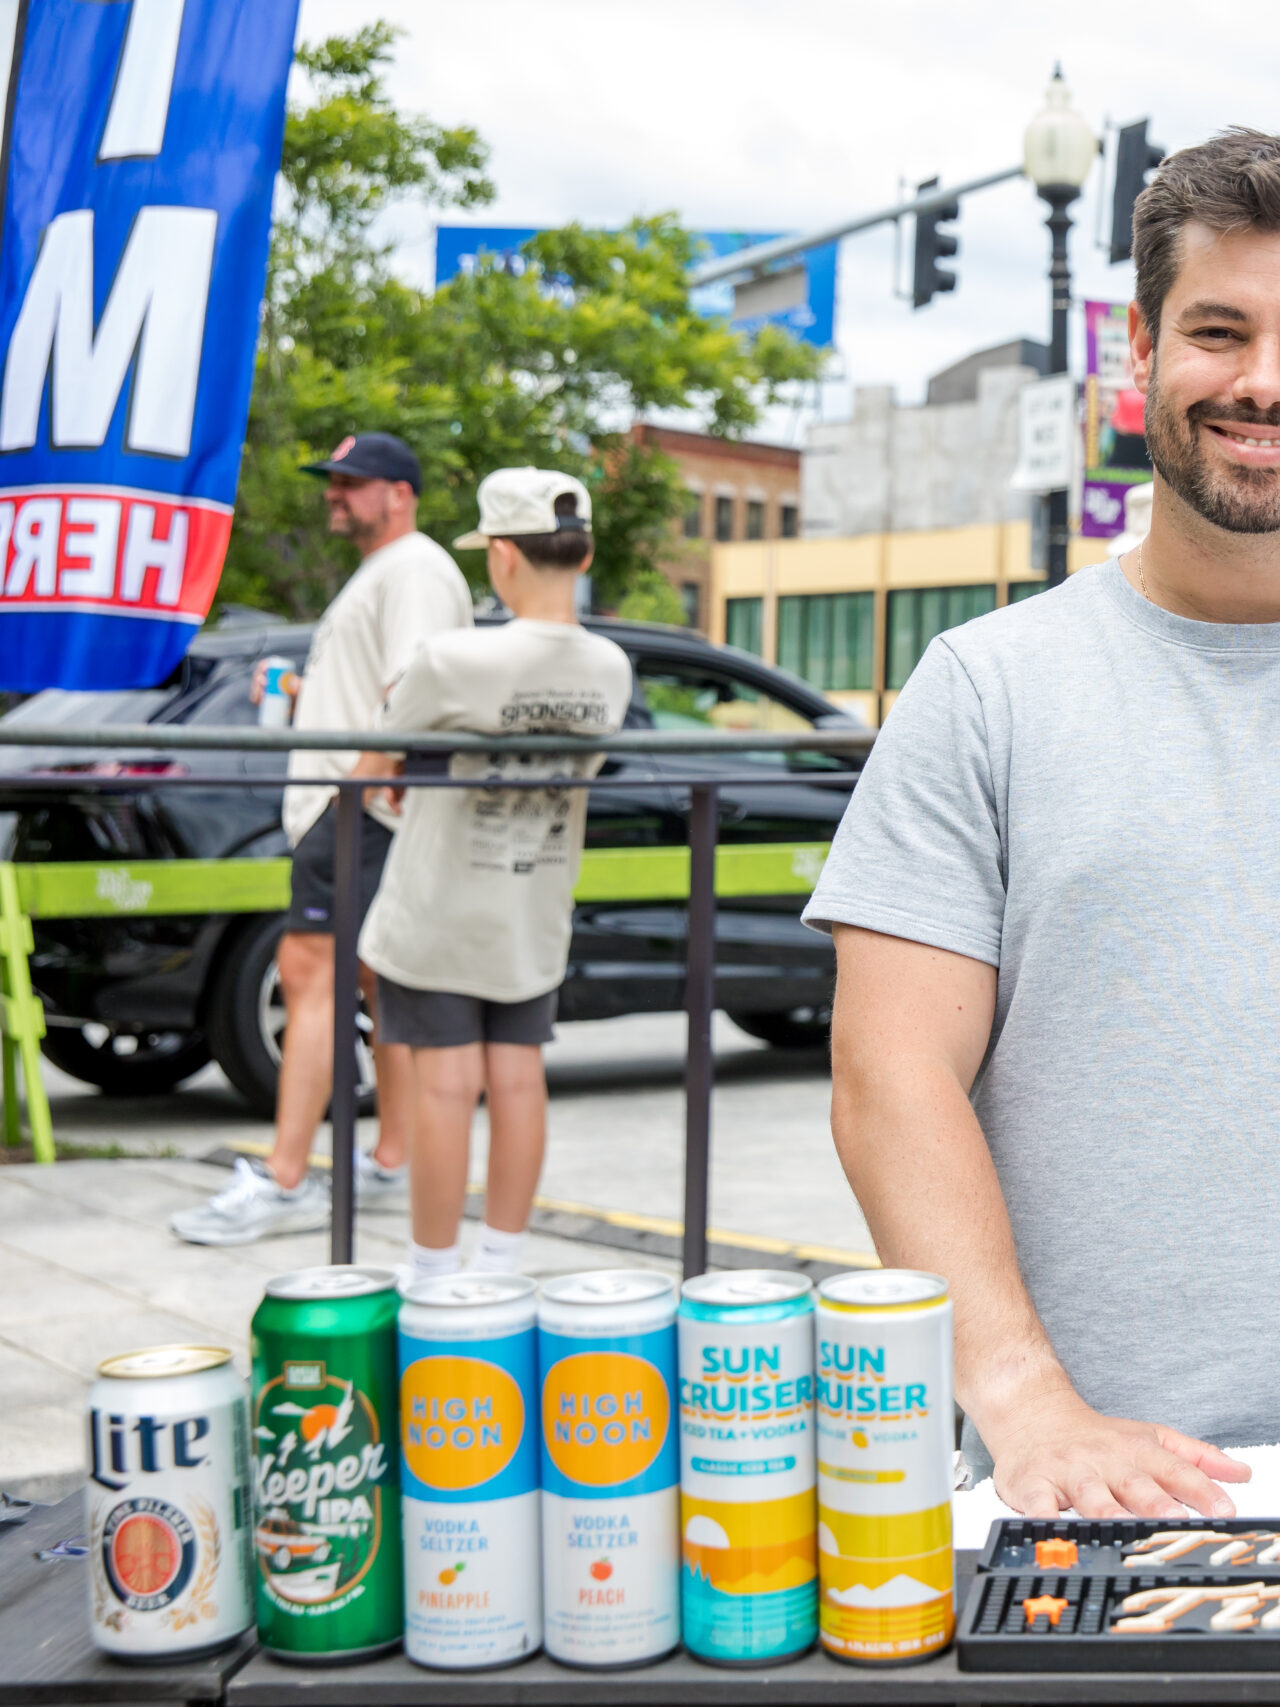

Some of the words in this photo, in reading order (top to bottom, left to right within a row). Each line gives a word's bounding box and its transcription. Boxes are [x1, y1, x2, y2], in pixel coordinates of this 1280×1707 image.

[702, 1345, 779, 1374] SUN
[821, 1341, 884, 1373] SUN
[559, 1391, 643, 1418] HIGH
[679, 1376, 813, 1412] CRUISER
[411, 1395, 493, 1421] HIGH
[408, 1421, 502, 1449] NOON
[554, 1417, 651, 1446] NOON
[709, 1427, 737, 1440] TEA
[750, 1419, 807, 1440] VODKA
[90, 1406, 210, 1491] Lite
[252, 1443, 389, 1519] Keeper
[317, 1496, 374, 1526] IPA
[573, 1515, 630, 1531] VODKA
[425, 1519, 480, 1534] VODKA
[420, 1536, 488, 1551] SELTZER
[568, 1532, 639, 1549] SELTZER
[418, 1589, 490, 1609] PINEAPPLE
[578, 1588, 626, 1606] PEACH
